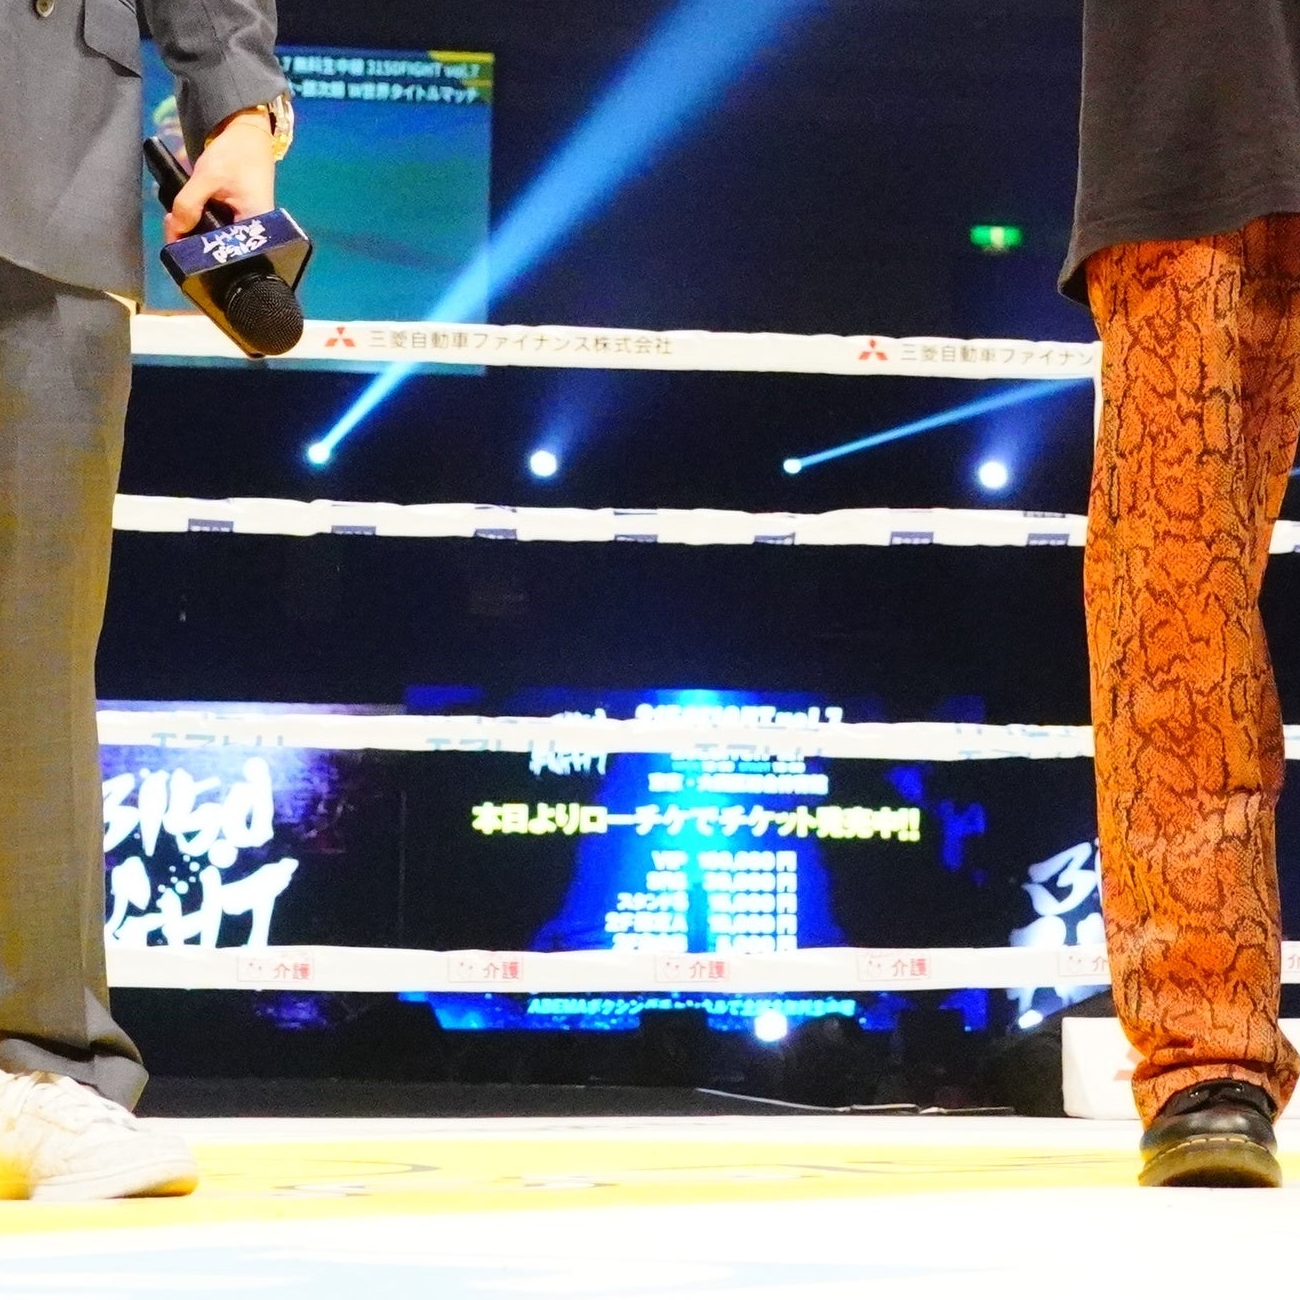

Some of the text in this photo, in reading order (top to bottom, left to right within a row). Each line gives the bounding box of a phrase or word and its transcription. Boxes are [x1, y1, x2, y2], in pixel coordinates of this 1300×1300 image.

[368, 329, 673, 355] 三菱自動車ファイナンス株式会社
[274, 962, 311, 980] 介護
[483, 961, 521, 980] 介護
[688, 961, 726, 980] 介護
[891, 958, 928, 978] 介護
